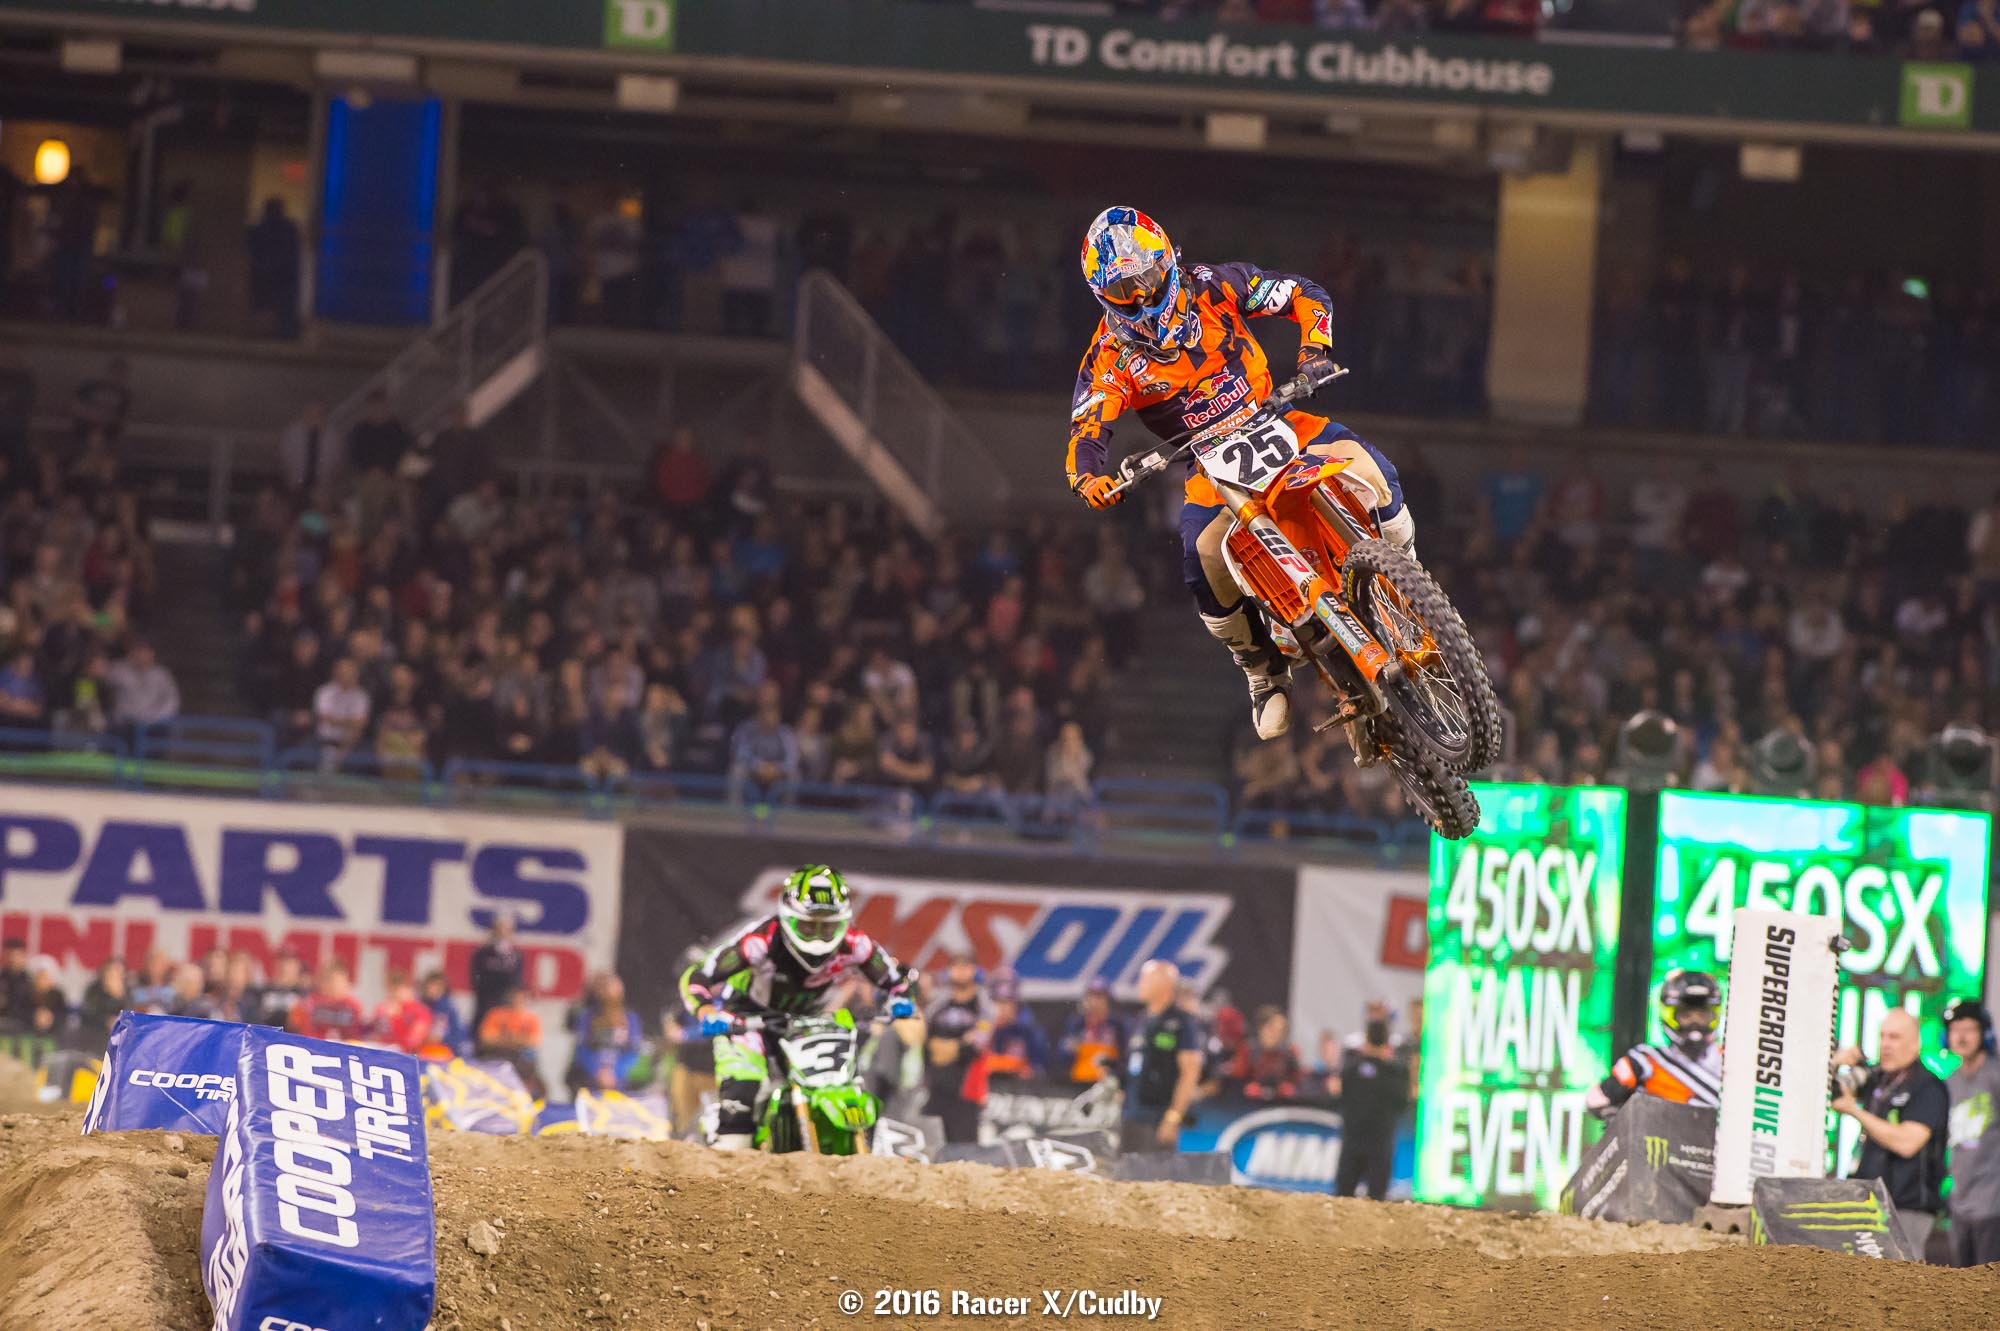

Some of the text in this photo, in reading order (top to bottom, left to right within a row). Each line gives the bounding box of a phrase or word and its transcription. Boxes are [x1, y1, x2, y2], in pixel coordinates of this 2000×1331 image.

[1026, 24, 1554, 95] TD Comfort Clubhouse
[1911, 74, 1965, 116] TD
[1263, 279, 1298, 315] KTM
[1182, 399, 1222, 429] Red
[1215, 376, 1249, 411] Bull
[1223, 424, 1294, 485] 25
[1327, 614, 1360, 653] MOTOREX
[0, 815, 591, 935] PARTS
[1446, 844, 1597, 953] 450SX
[0, 912, 586, 999] NLIMITD
[763, 893, 1210, 978] MSOIL
[801, 1038, 850, 1077] 3
[1458, 967, 1581, 1073] MAIN
[128, 1069, 236, 1092] COOPE
[195, 1088, 231, 1103] TIR
[1746, 924, 1796, 1196] SUPERCROSSLIVE.CO
[265, 1043, 360, 1248] COOPER
[349, 1056, 413, 1163] TIRES
[1441, 1089, 1588, 1196] EVENT
